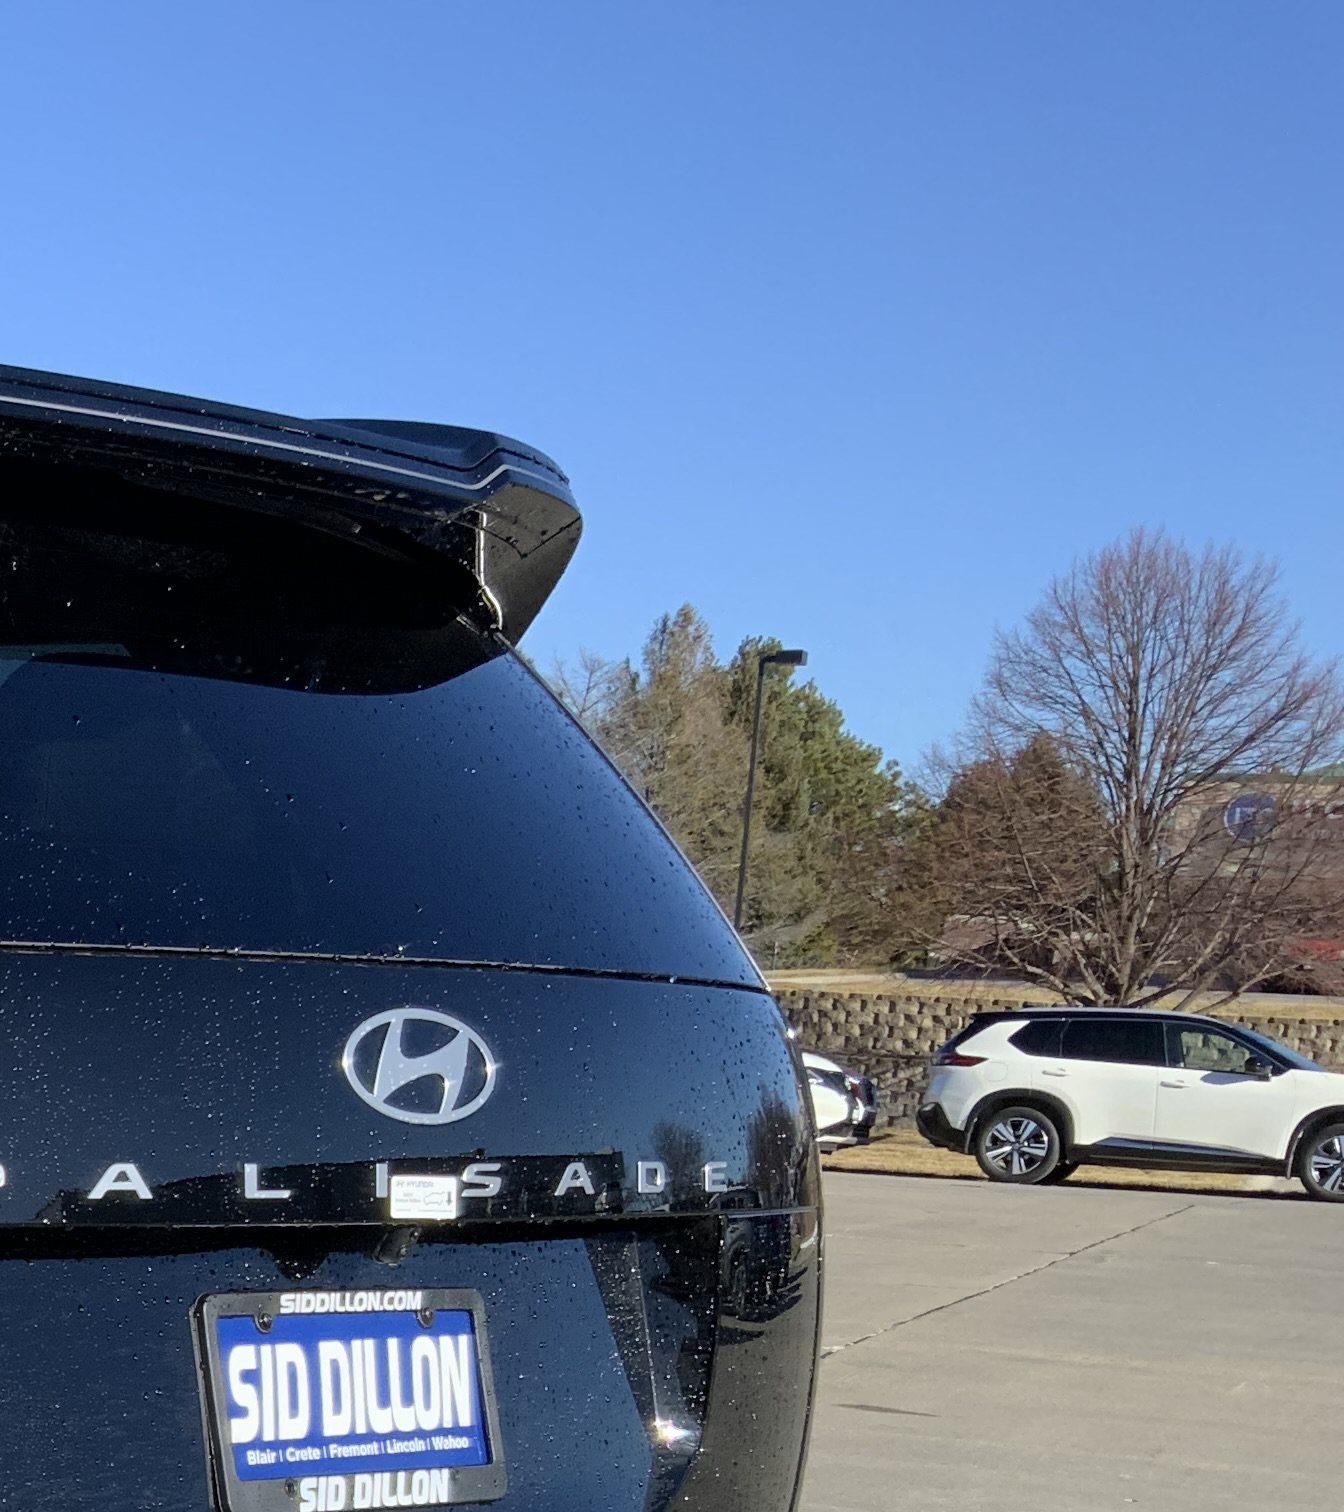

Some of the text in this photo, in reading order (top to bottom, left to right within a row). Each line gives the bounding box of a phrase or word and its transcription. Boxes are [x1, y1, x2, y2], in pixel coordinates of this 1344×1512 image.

[280, 1291, 423, 1314] SIDDILLON.COM
[229, 1334, 473, 1444] SID DILLON
[246, 1435, 470, 1466] Blair Crete Fremont Lincoln Wahoo
[353, 1468, 450, 1509] DILLON
